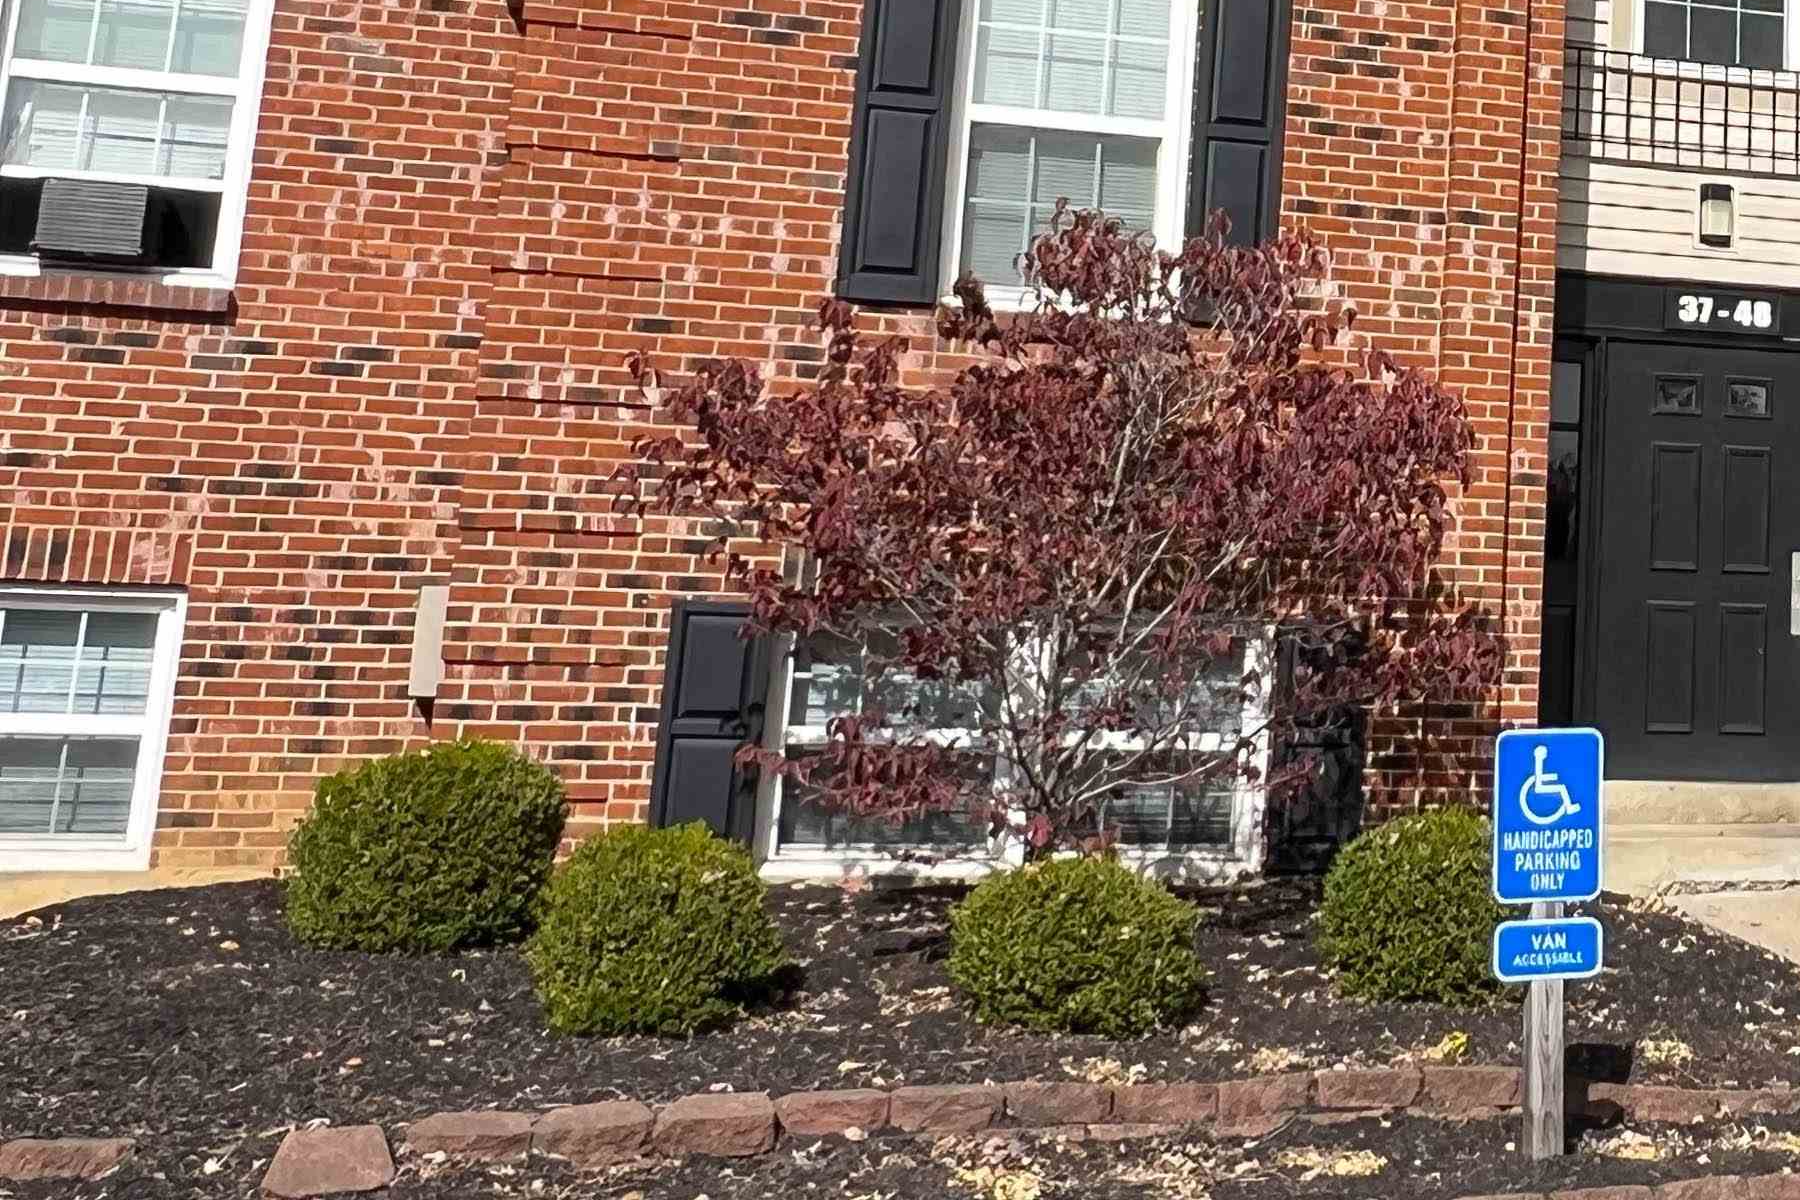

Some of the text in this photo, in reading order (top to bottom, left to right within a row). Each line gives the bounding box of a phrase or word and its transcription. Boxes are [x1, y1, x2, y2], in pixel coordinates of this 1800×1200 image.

[1503, 828, 1593, 850] HANDICAPPED
[1515, 850, 1581, 872] PARKING
[1530, 872, 1565, 891] ONLY
[1531, 932, 1567, 951] VAN
